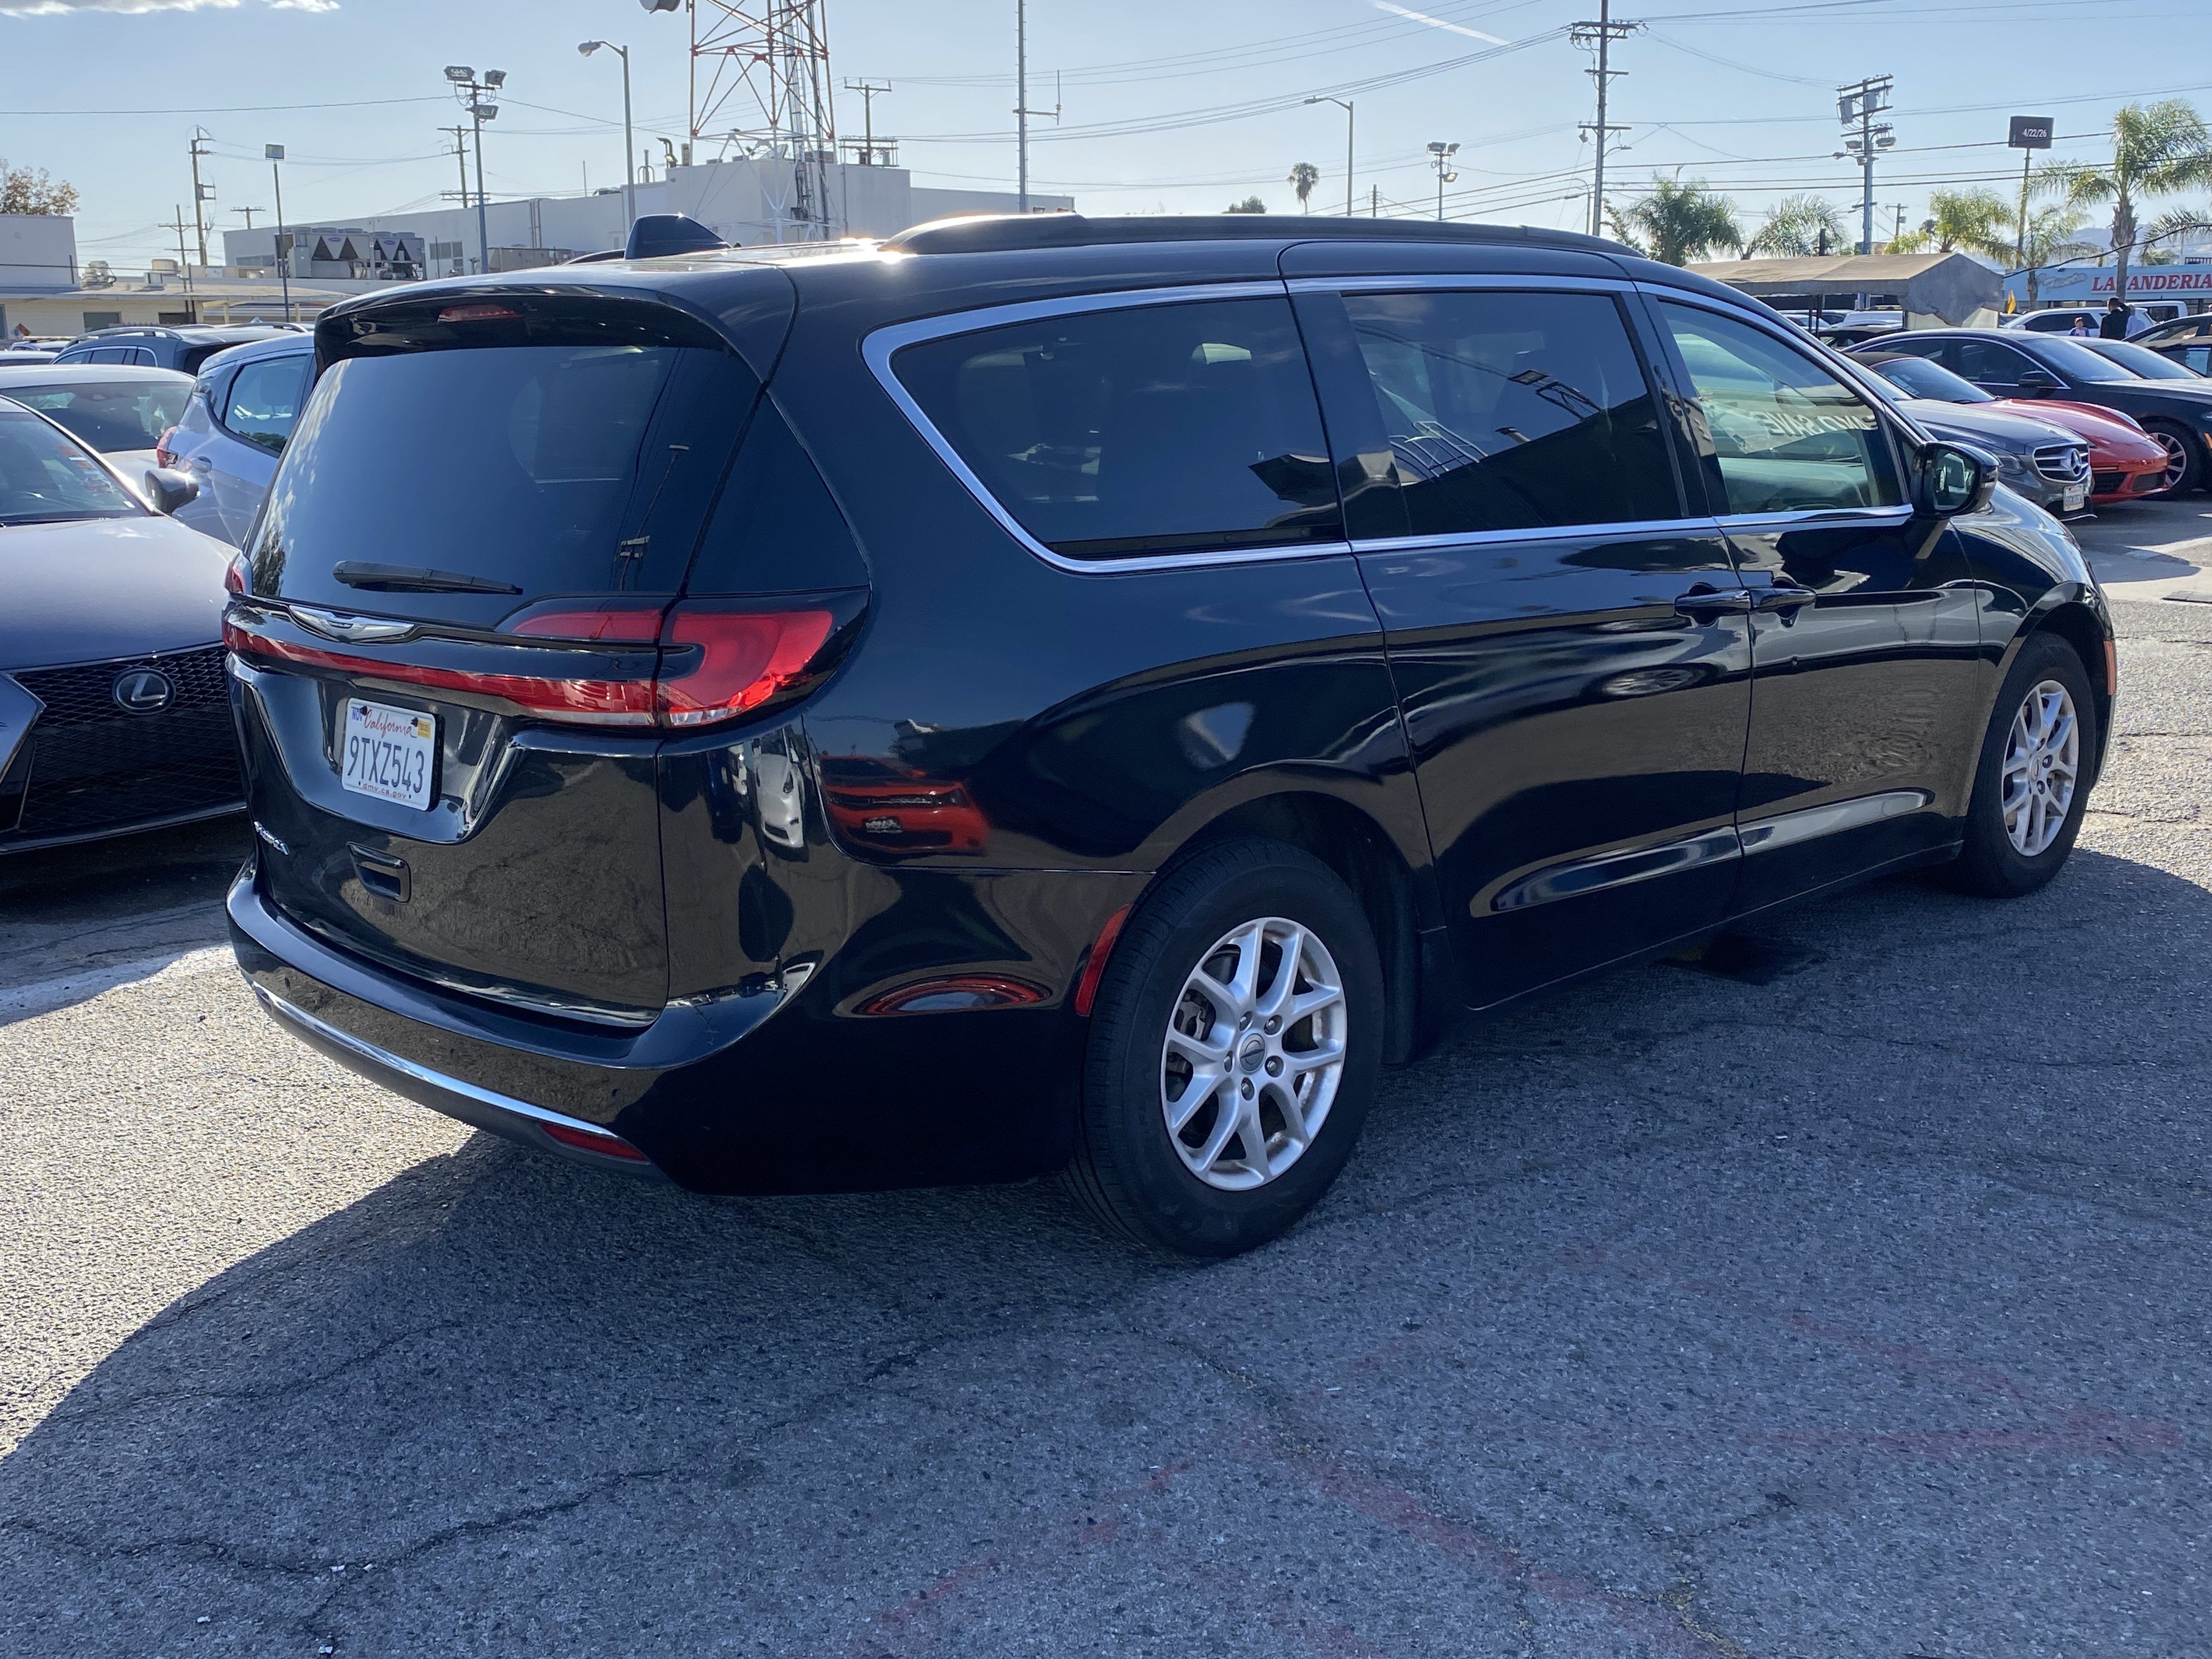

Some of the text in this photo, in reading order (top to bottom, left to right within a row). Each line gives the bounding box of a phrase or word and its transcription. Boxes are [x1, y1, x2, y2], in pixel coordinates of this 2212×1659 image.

[2022, 128, 2047, 138] 4/22/26
[2091, 274, 2212, 291] LAANDERIA
[363, 708, 417, 738] California
[347, 736, 425, 794] 9TXZ543
[363, 783, 407, 799] dmv.ca.gov
